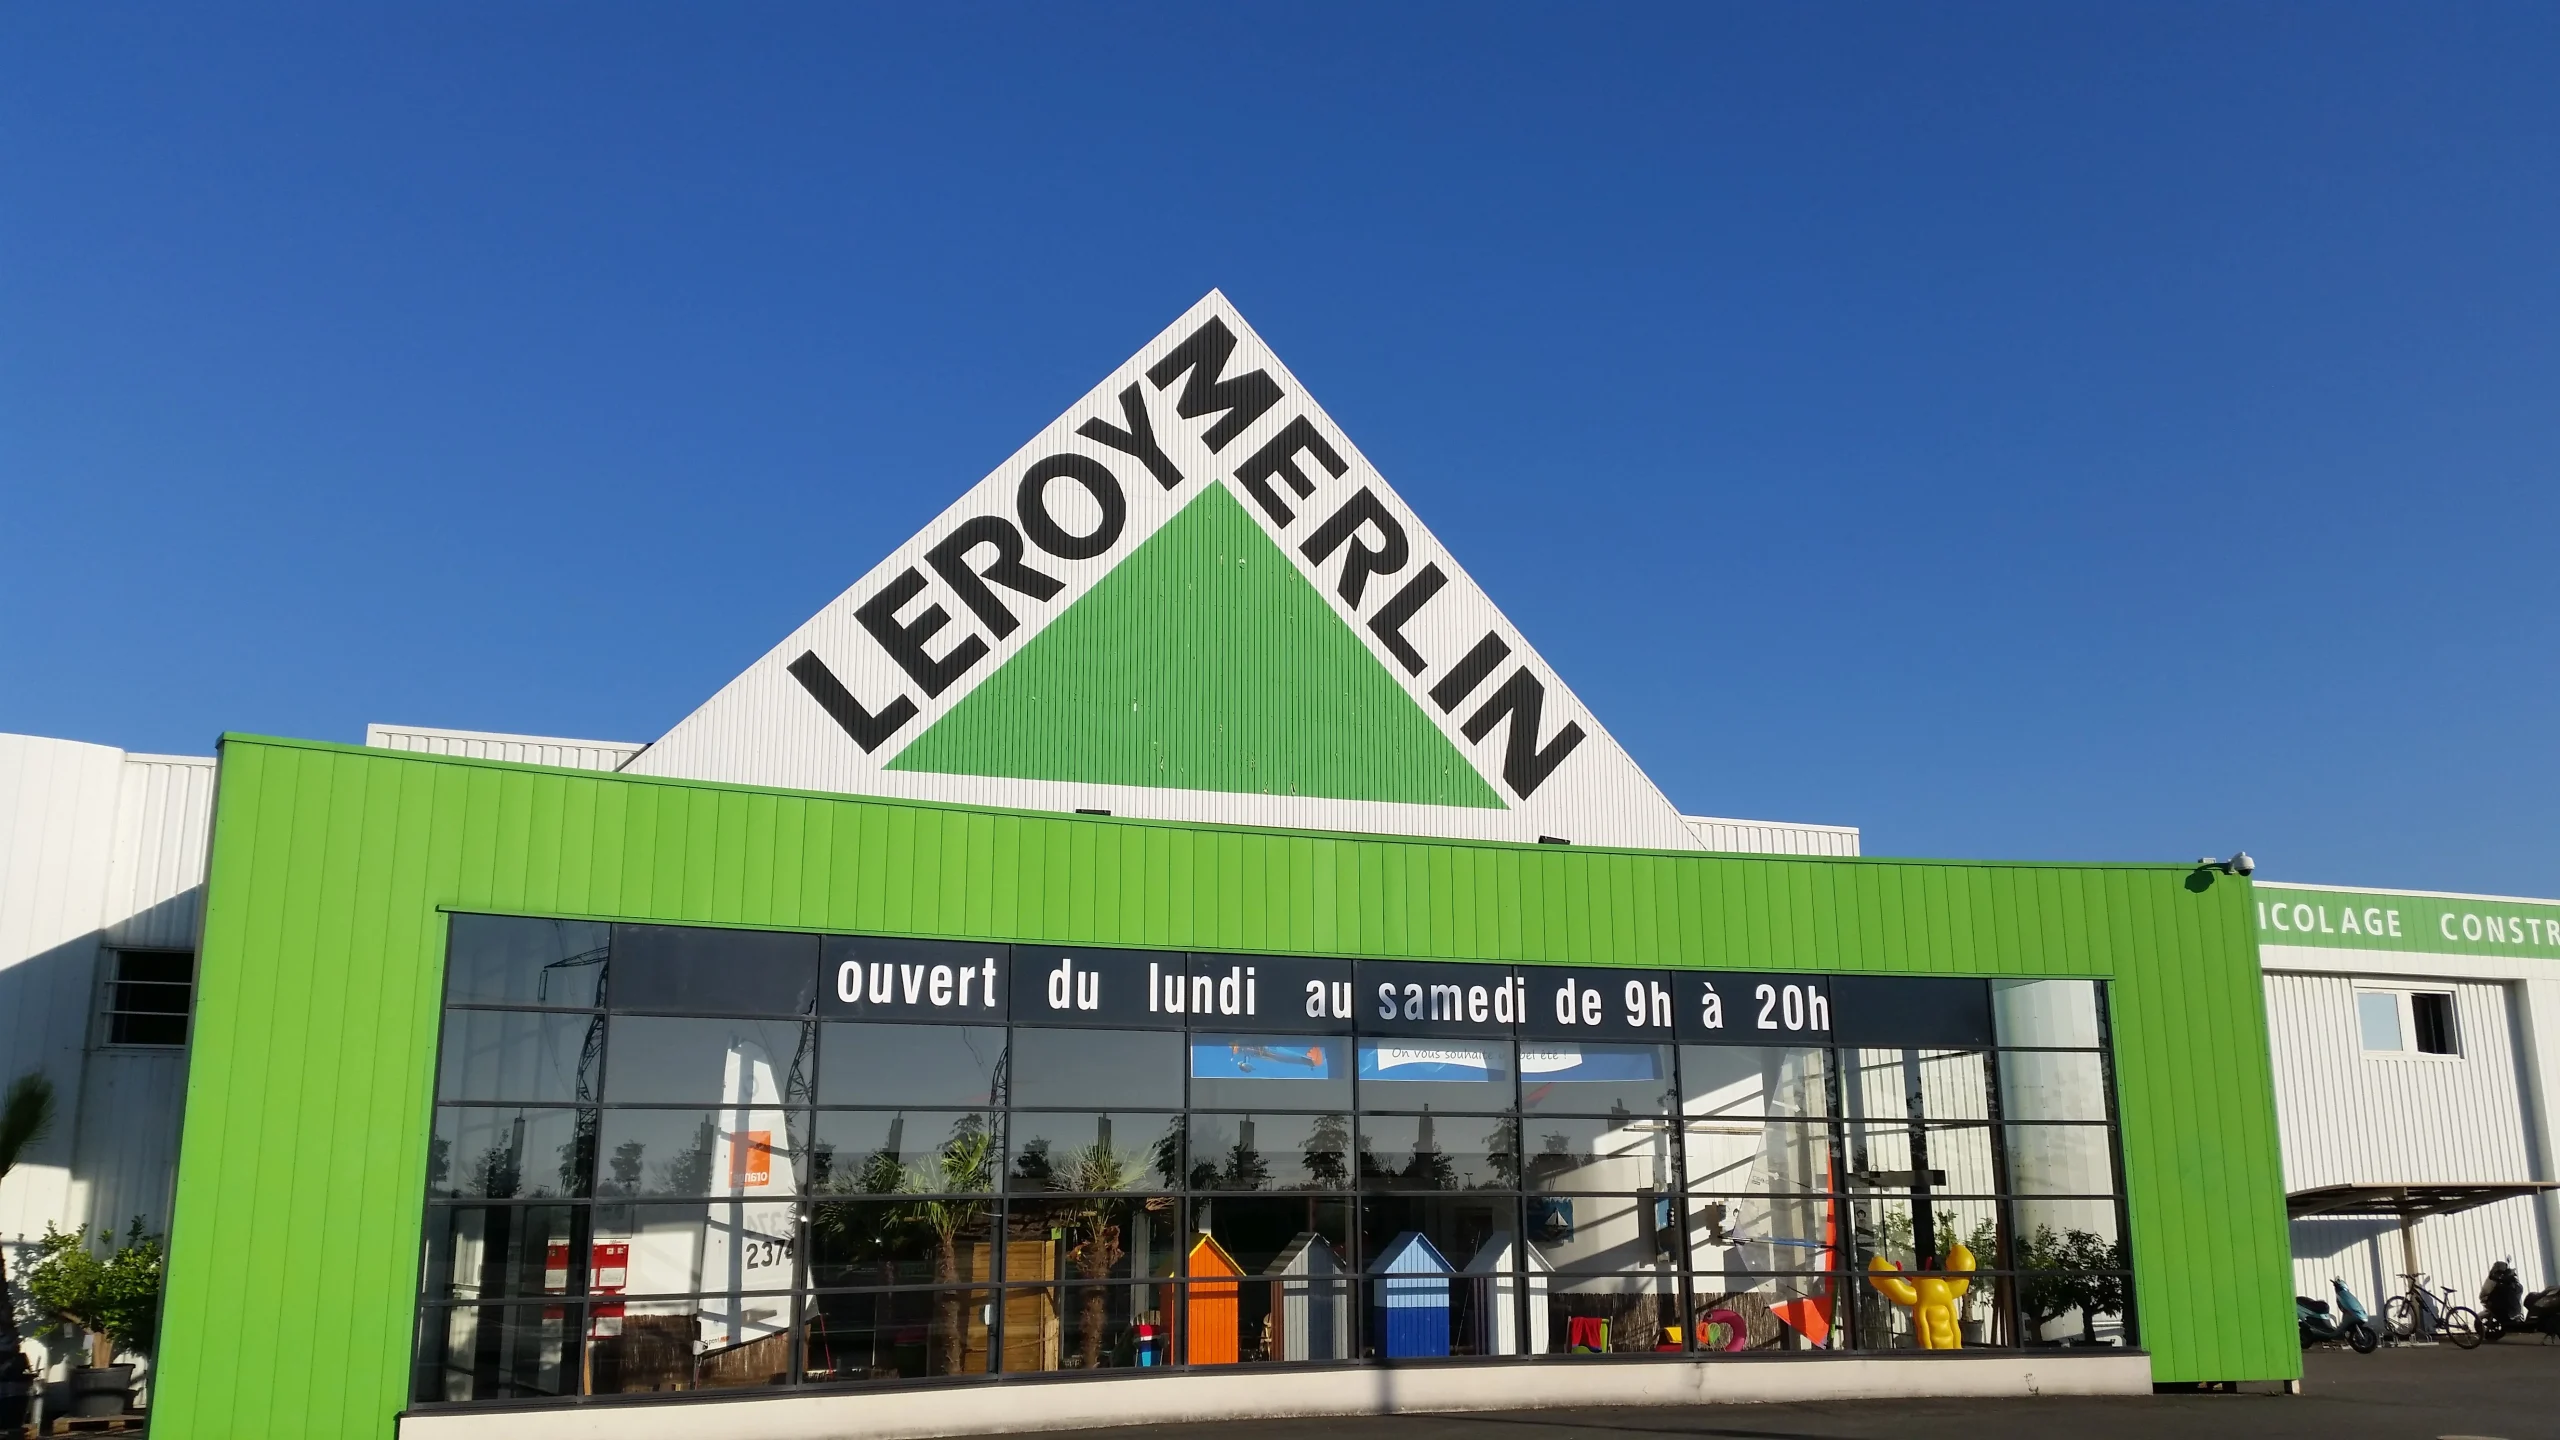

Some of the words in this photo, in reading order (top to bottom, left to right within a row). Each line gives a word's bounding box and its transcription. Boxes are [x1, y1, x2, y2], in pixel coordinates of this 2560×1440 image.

[787, 381, 1184, 754] LEROY
[1146, 315, 1586, 801] MERLIN
[2440, 913, 2560, 946] CONSTR
[837, 957, 997, 1008] ouvert
[1048, 958, 1099, 1010] du
[1149, 962, 1255, 1016] lundi
[1305, 979, 1352, 1019] au
[1378, 976, 1526, 1024] samedi
[1556, 977, 1602, 1026] de
[1625, 979, 1672, 1028] 9h
[1701, 982, 1724, 1029] à
[1756, 983, 1830, 1031] 20h
[1391, 1047, 1410, 1058] On
[1414, 1050, 1440, 1059] vous
